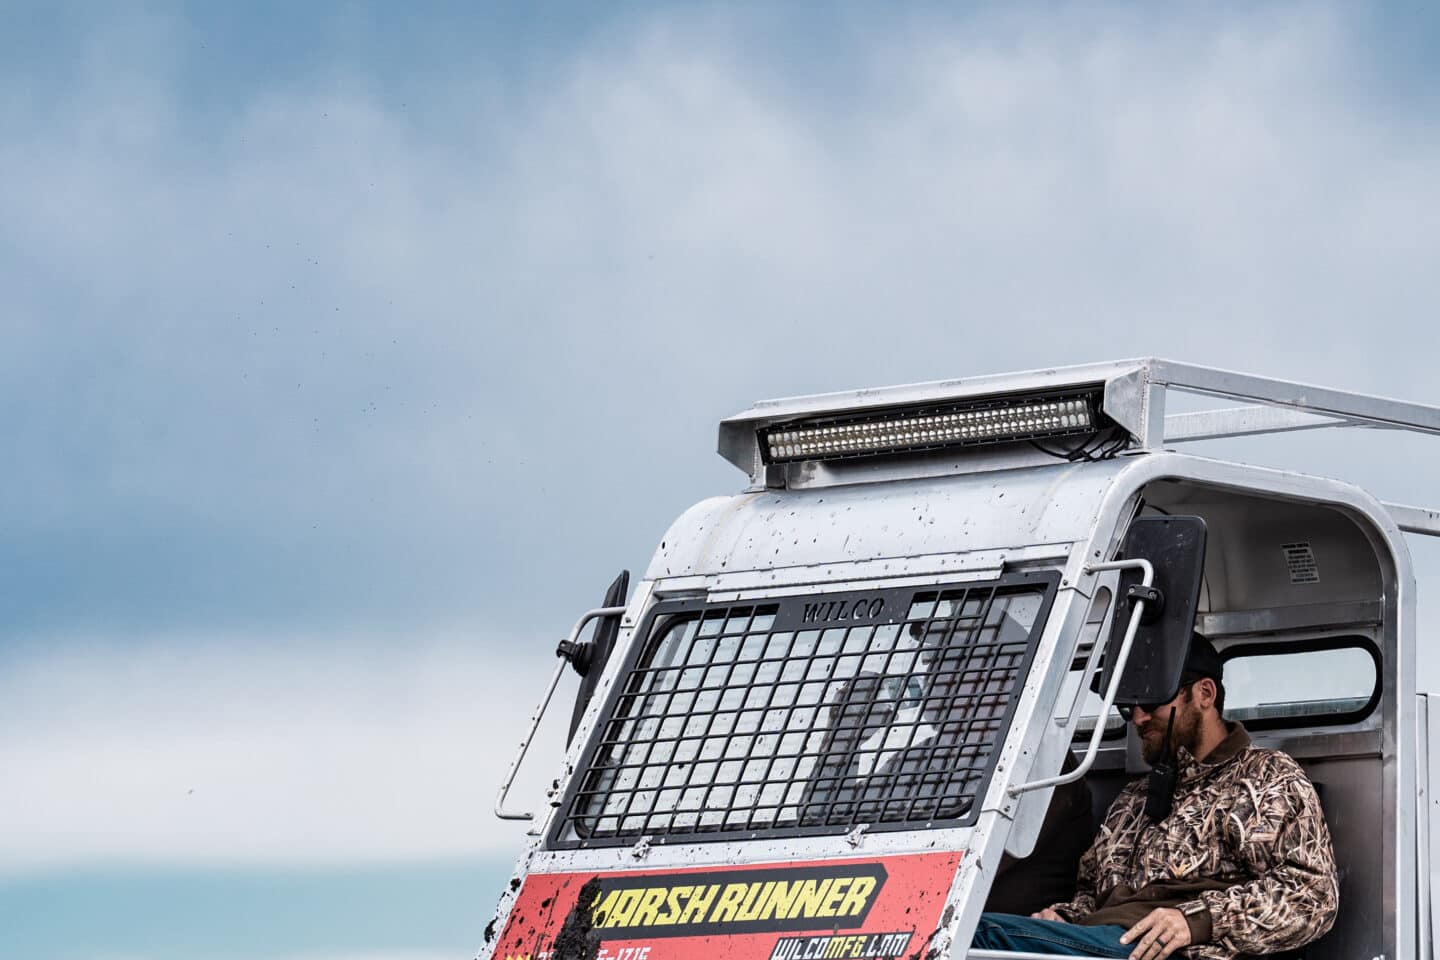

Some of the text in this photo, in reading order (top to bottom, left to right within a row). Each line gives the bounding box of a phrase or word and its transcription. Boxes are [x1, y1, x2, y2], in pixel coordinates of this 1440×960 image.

[802, 597, 885, 624] WILCO
[592, 875, 878, 929] MARSH RUNNER
